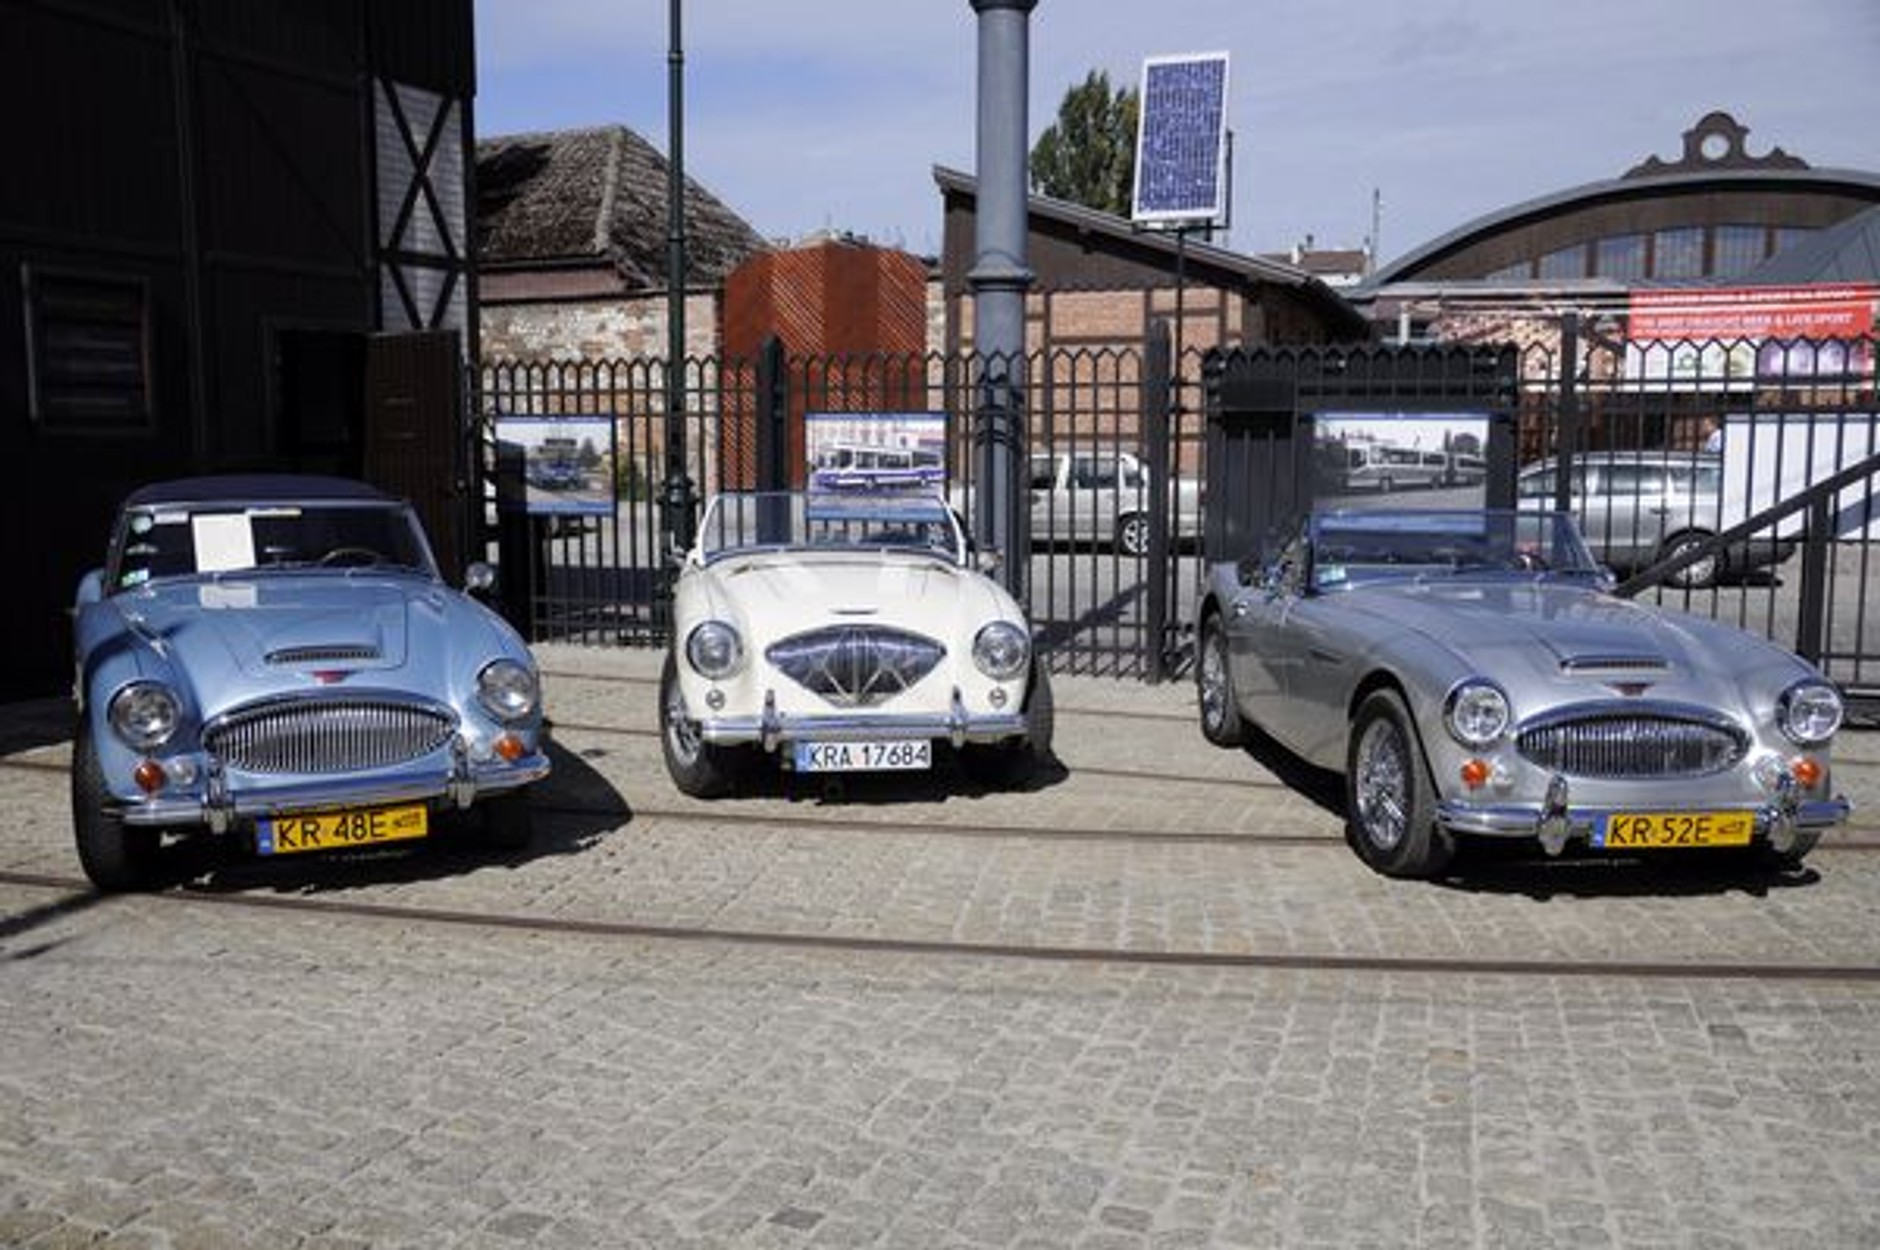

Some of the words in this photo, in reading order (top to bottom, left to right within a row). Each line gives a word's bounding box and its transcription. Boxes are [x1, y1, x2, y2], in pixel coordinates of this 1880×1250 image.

[809, 744, 852, 768] KRA
[861, 743, 929, 766] 17684
[278, 819, 321, 847] KR
[333, 810, 387, 841] 48E
[1610, 817, 1651, 844] KR
[1661, 816, 1712, 844] 52E
